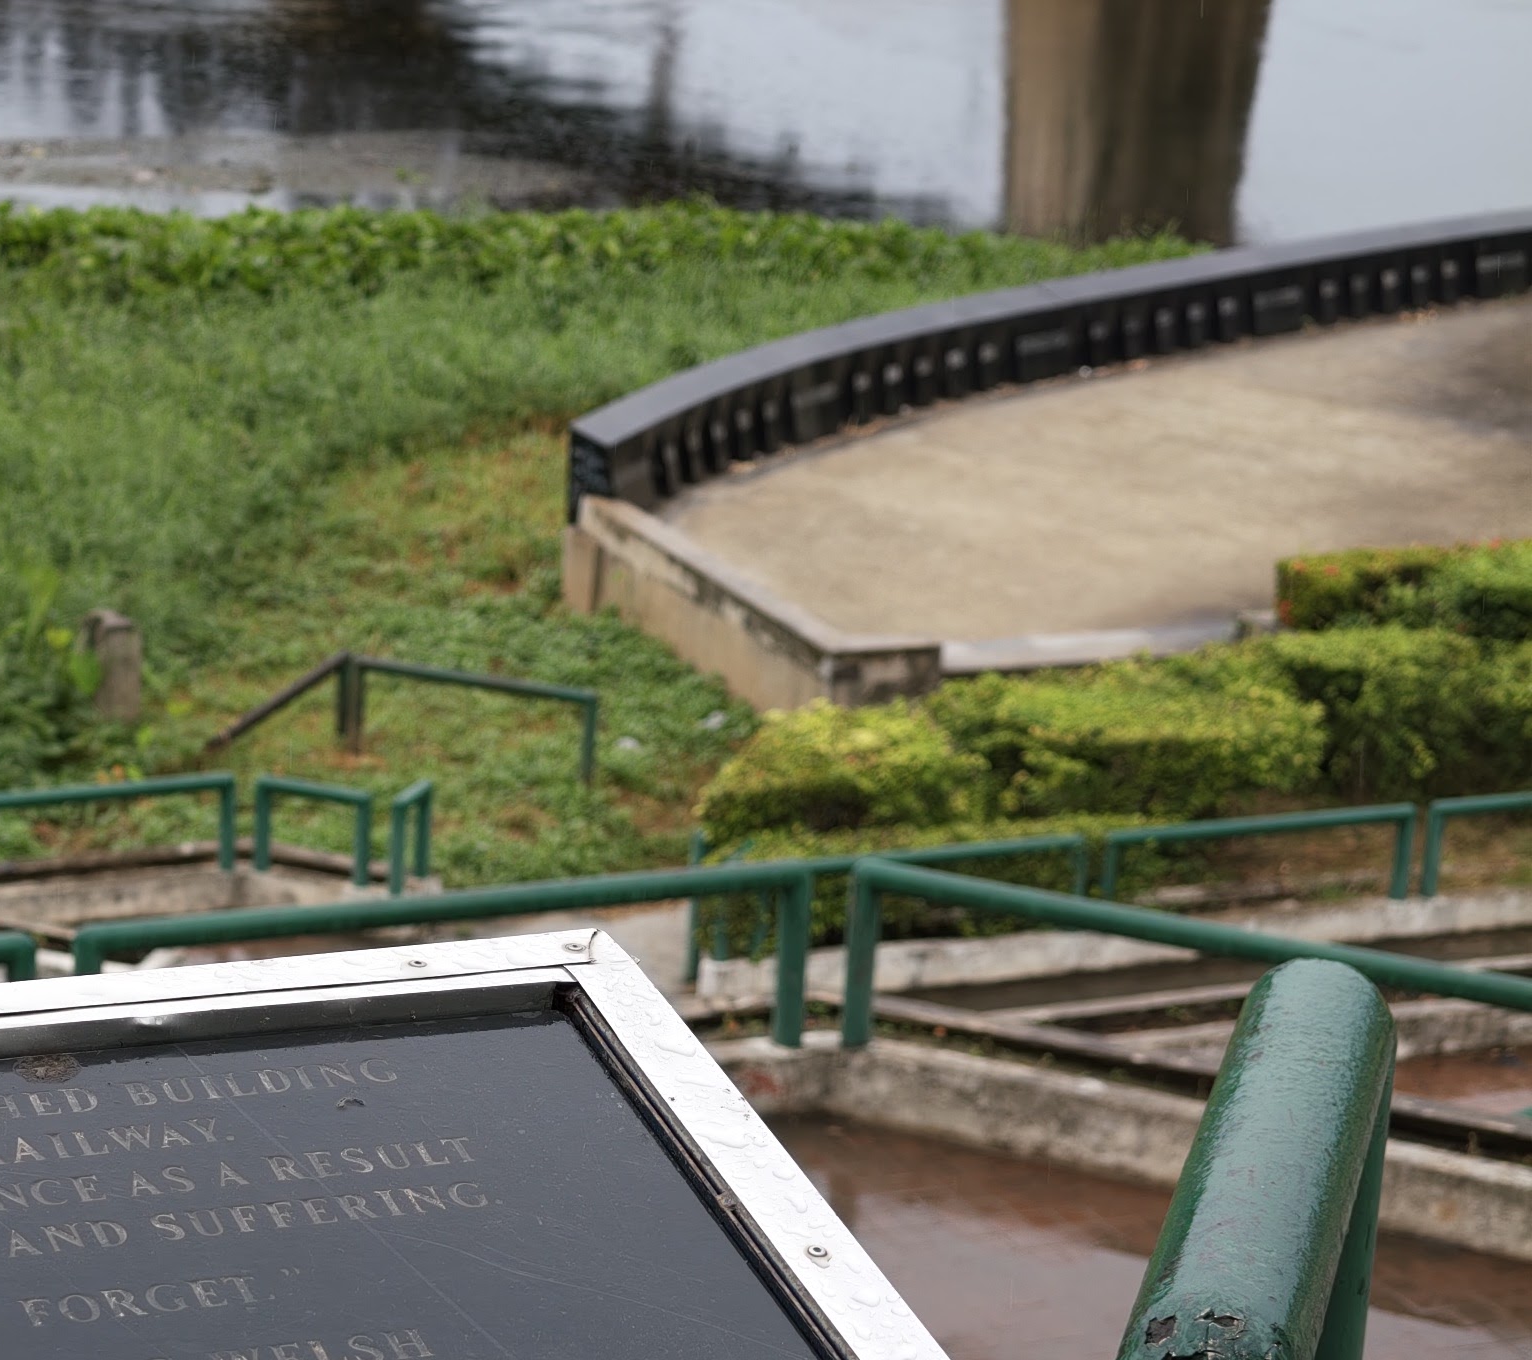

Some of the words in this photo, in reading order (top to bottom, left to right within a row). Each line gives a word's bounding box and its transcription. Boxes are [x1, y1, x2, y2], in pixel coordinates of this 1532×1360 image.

[126, 1056, 401, 1109] BUILDING
[130, 1163, 196, 1199] AS
[218, 1159, 252, 1188] A
[269, 1135, 476, 1183] RESULT
[7, 1219, 129, 1260] AND
